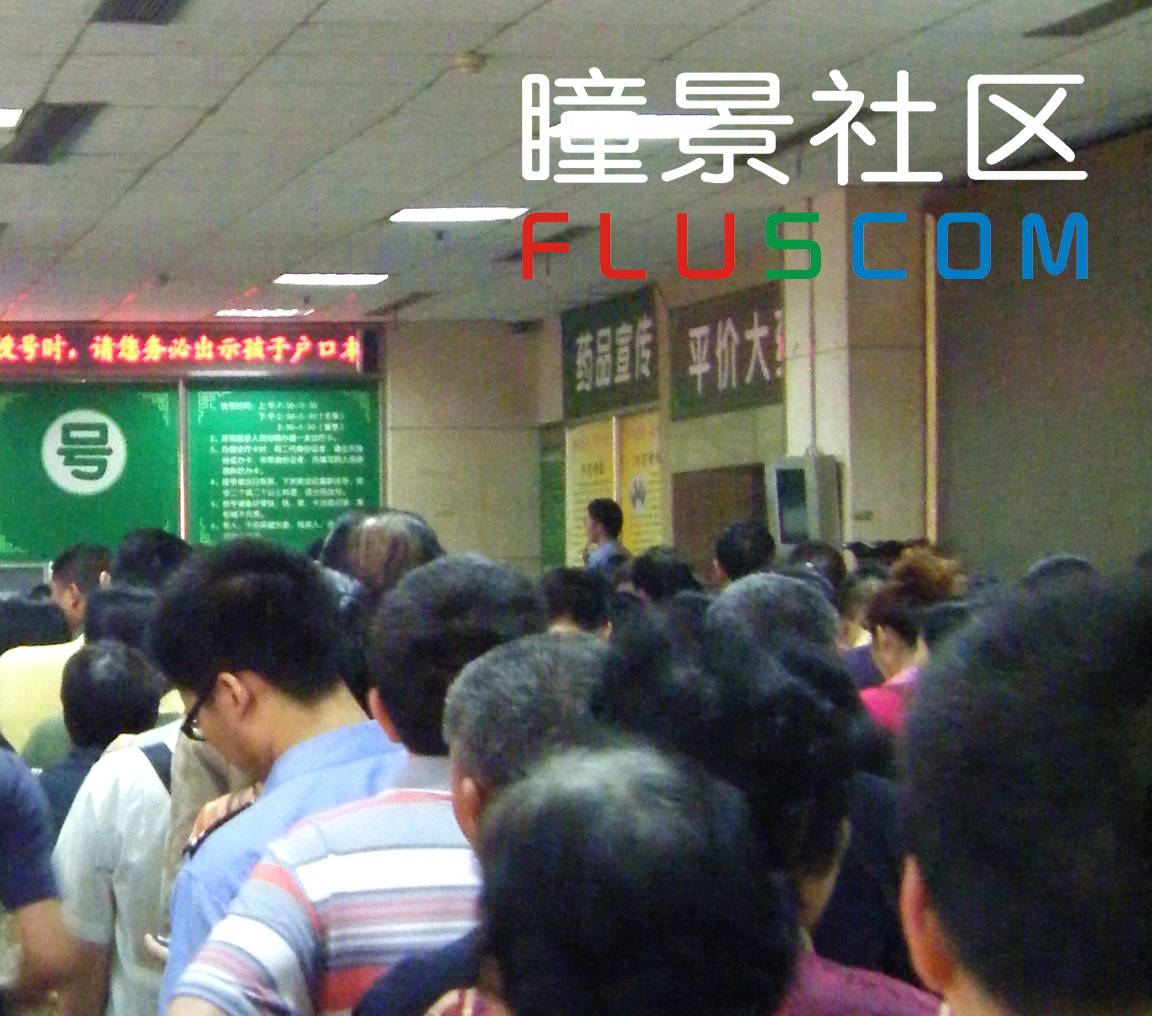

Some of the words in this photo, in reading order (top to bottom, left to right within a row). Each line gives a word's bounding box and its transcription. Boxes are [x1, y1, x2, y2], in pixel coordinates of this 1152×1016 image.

[575, 315, 652, 391] 药品宣传
[56, 422, 114, 479] 号
